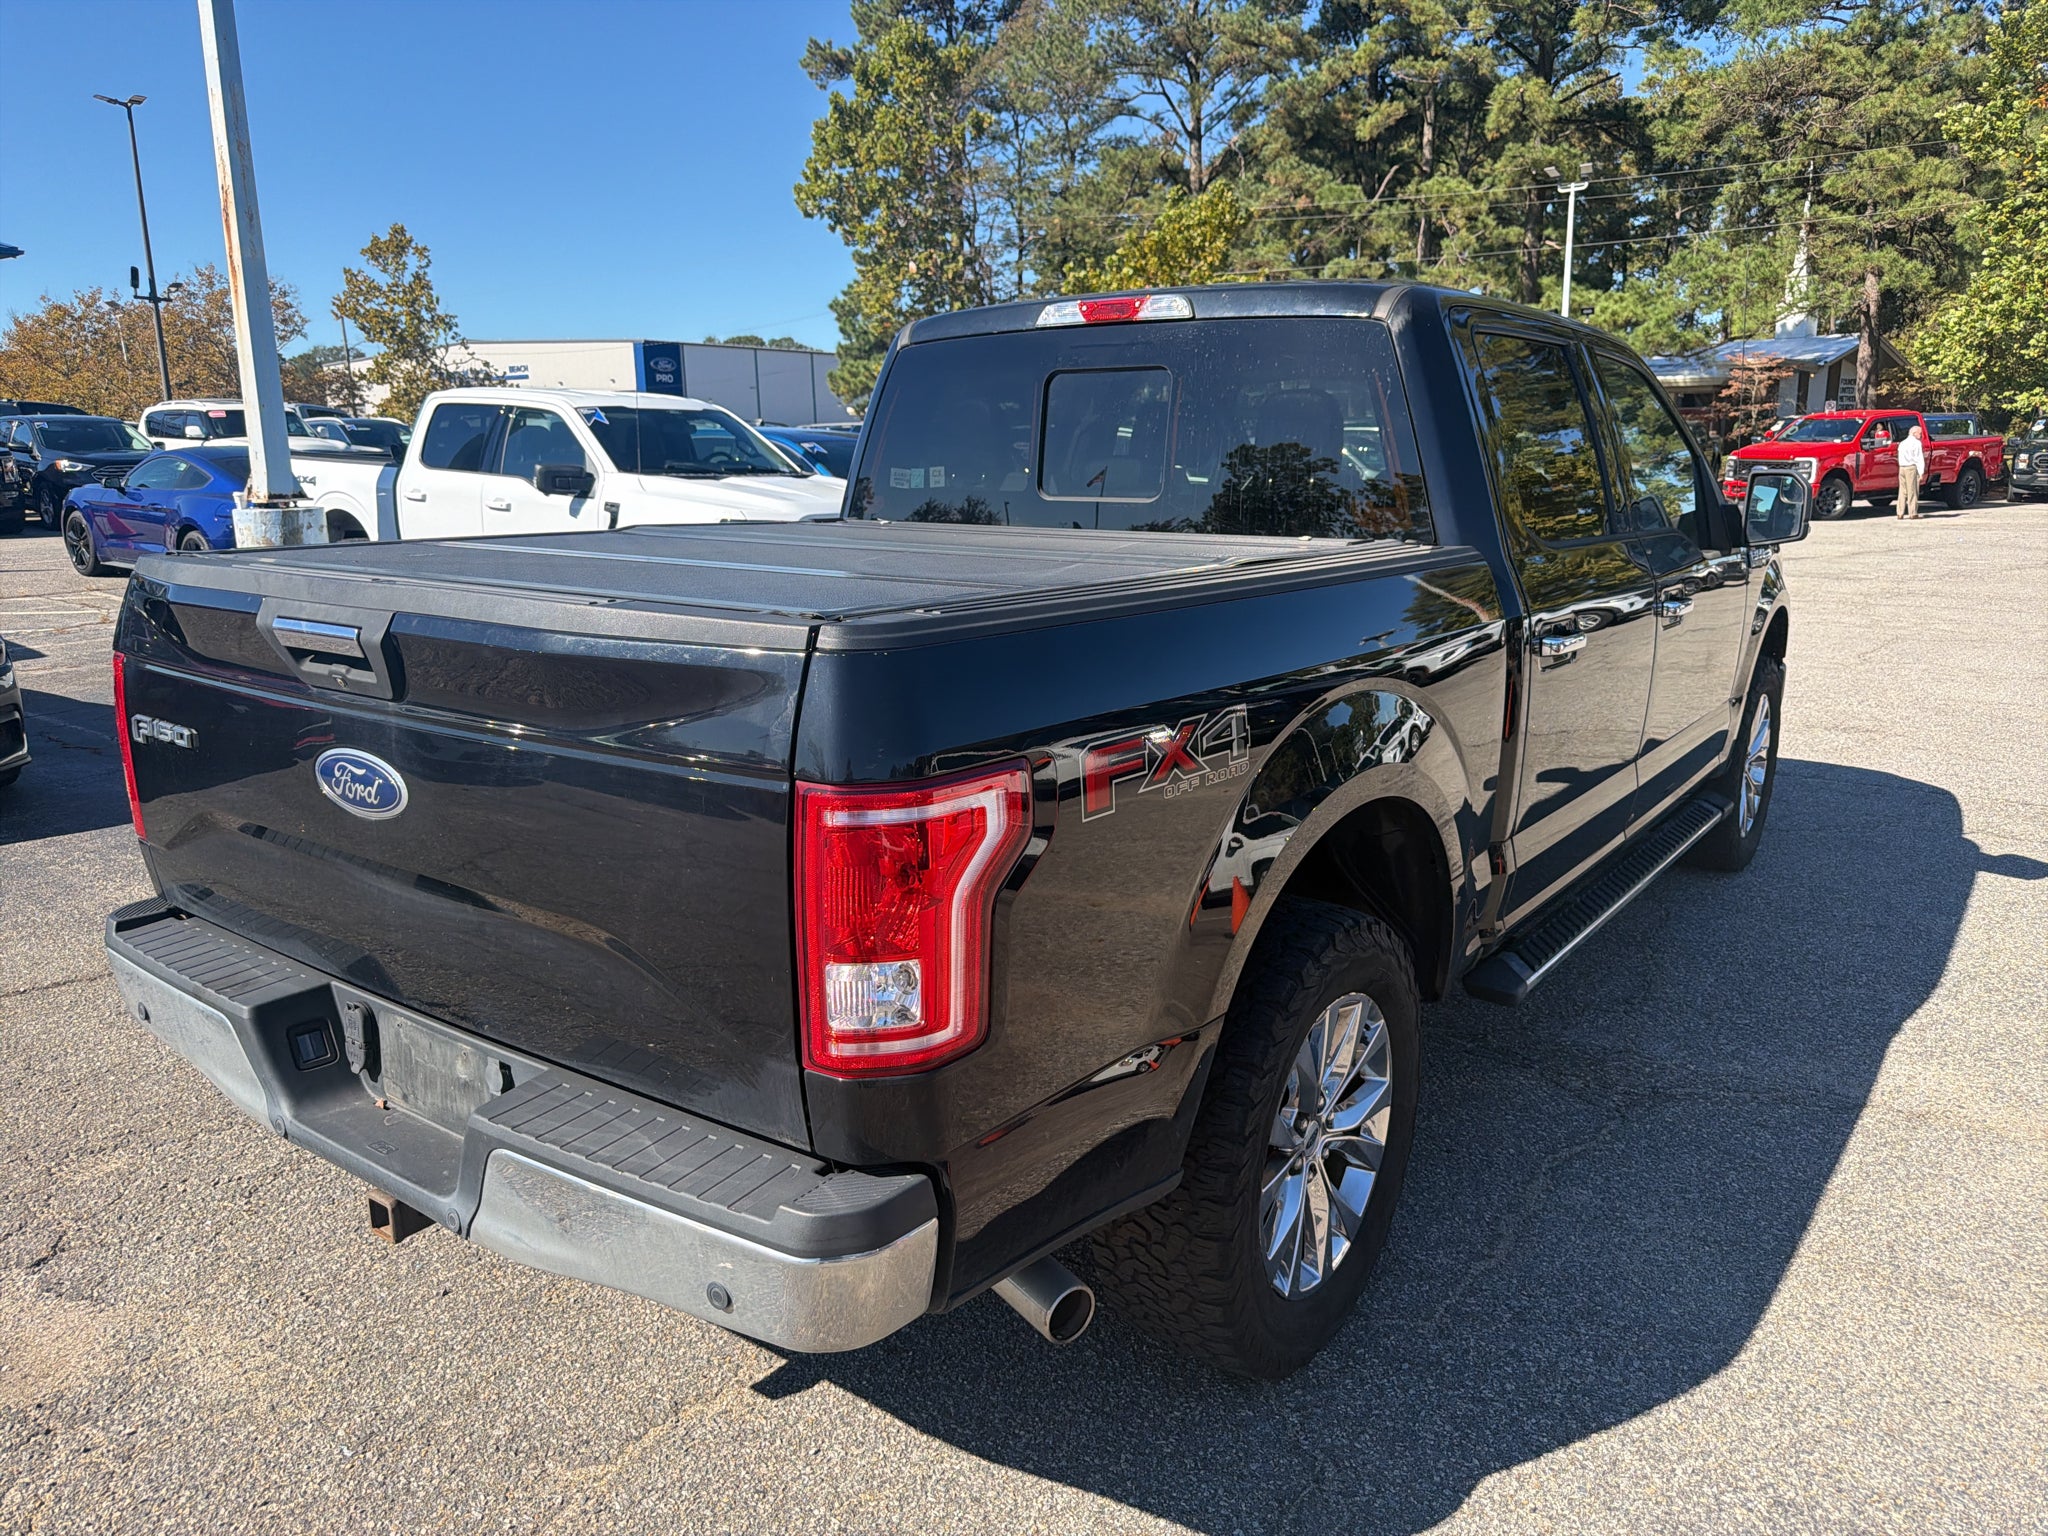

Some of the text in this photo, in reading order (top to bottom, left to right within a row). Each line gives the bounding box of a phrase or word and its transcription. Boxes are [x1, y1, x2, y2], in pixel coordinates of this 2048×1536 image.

[656, 373, 674, 383] PRO
[1079, 703, 1251, 823] FX4
[1164, 760, 1250, 799] OFF ROAD
